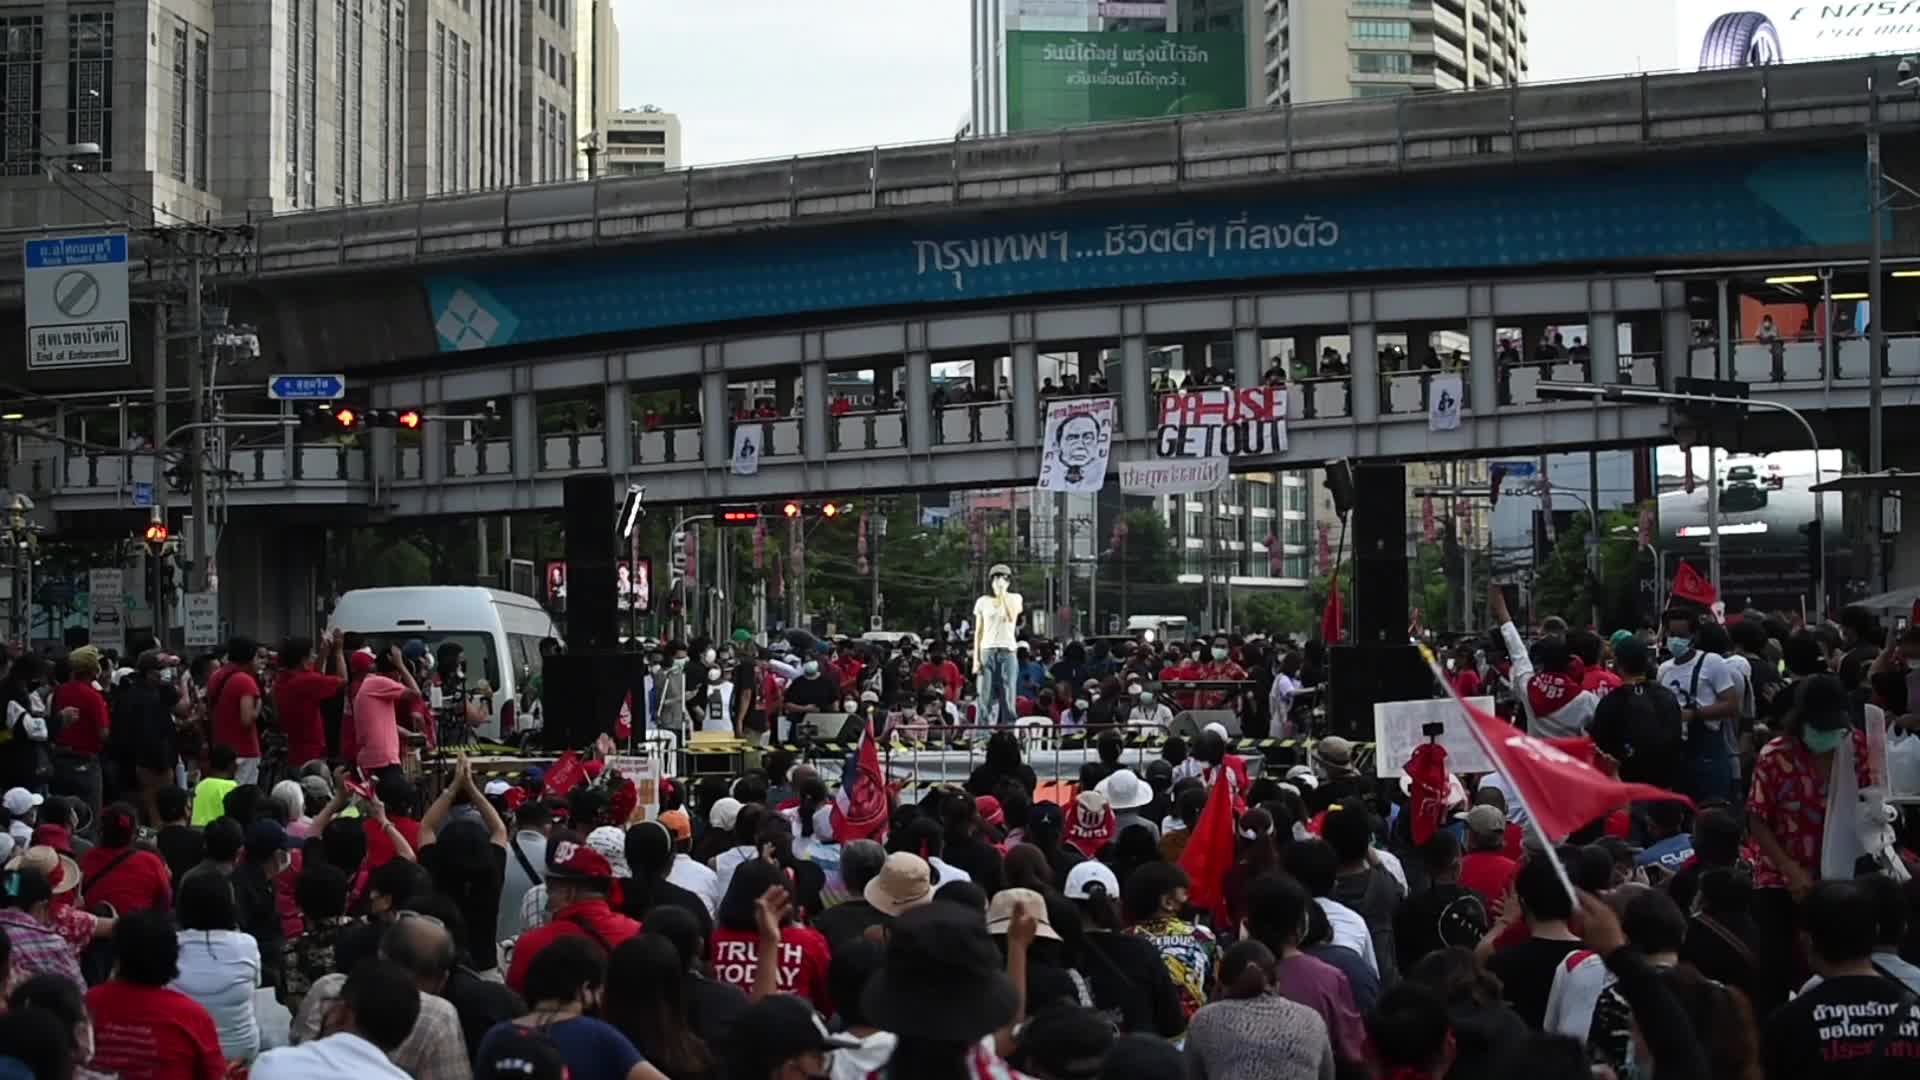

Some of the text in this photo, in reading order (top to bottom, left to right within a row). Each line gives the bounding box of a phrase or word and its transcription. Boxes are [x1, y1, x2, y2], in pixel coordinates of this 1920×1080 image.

[1041, 39, 1209, 67] วันนี้ได้อยู่ พรุ่งนี้ได้อีก
[1224, 212, 1340, 251] ที่ลงตัว
[36, 351, 53, 362] End
[56, 351, 65, 361] of
